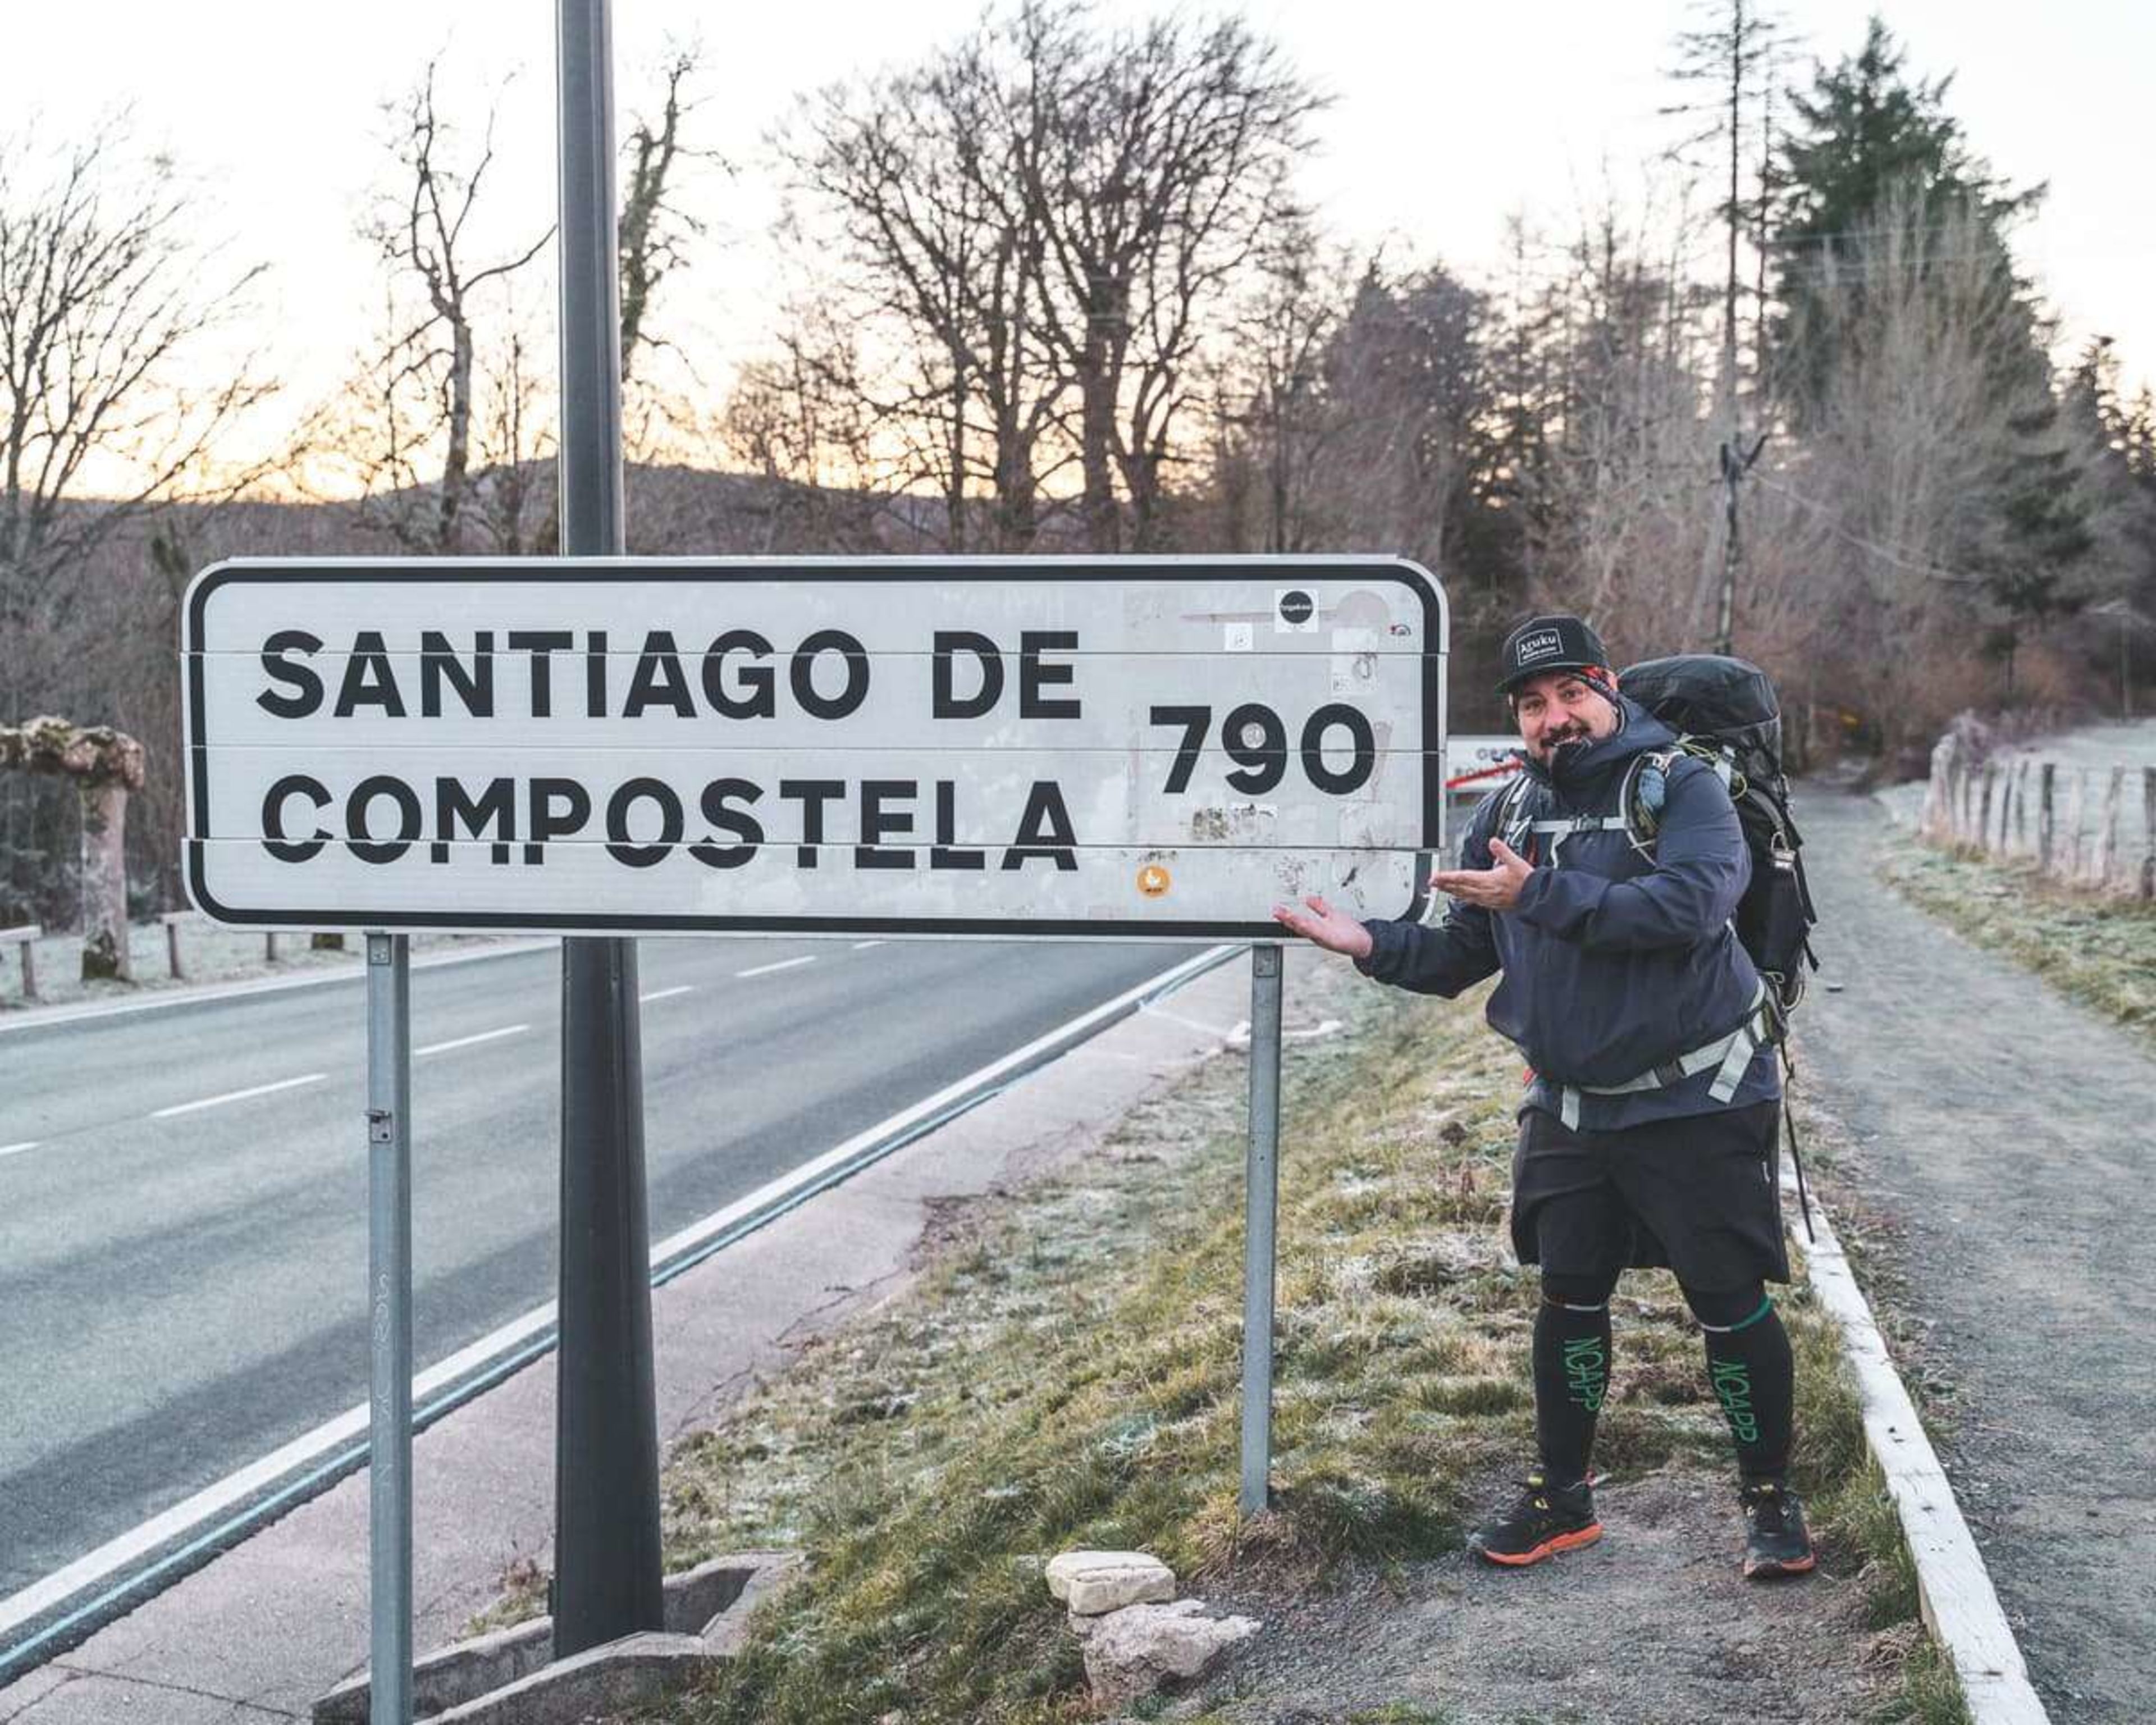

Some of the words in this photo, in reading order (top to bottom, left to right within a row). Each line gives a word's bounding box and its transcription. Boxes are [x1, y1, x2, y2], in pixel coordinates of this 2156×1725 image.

[257, 629, 870, 720] SANTIAGO
[933, 631, 1081, 719] DE
[1520, 632, 1557, 654] Aruku
[1150, 704, 1376, 795] 790
[262, 775, 1079, 871] COMPOSTELA
